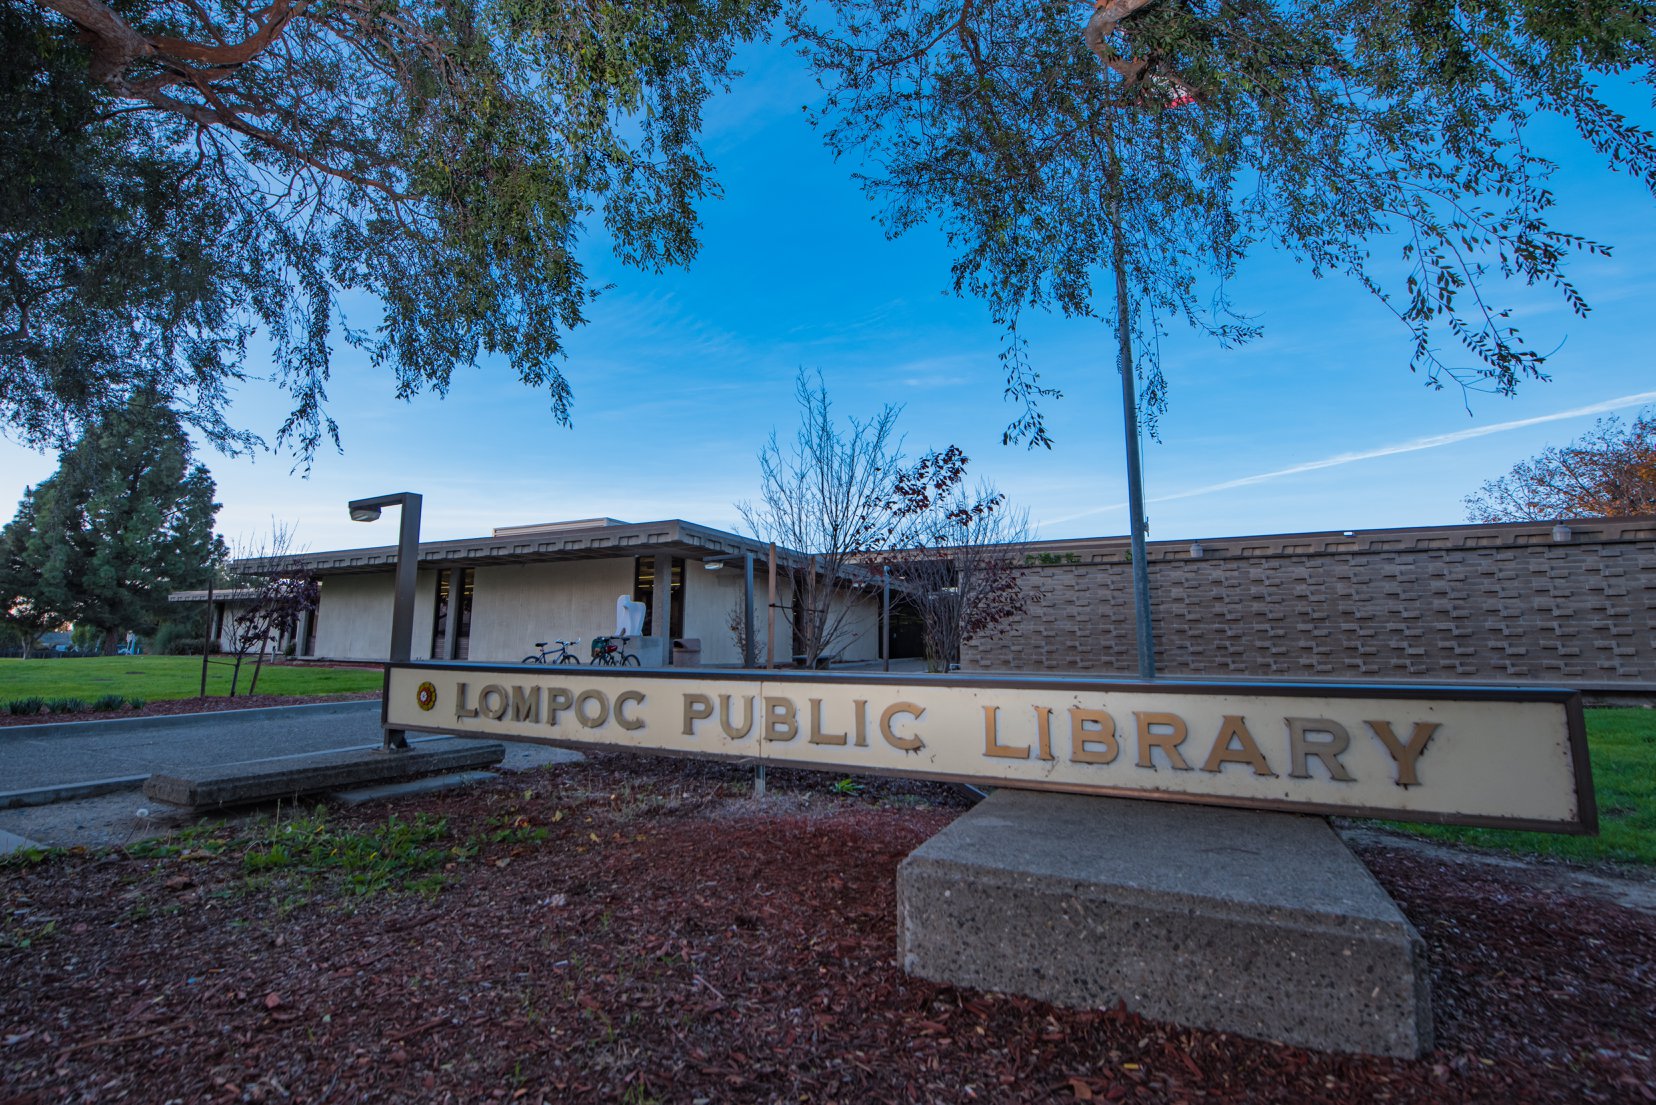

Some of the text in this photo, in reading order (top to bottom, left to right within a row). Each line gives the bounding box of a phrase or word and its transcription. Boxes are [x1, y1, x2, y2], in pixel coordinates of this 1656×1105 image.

[455, 682, 1443, 786] LOMPOC PUBLIC LIBRARY
